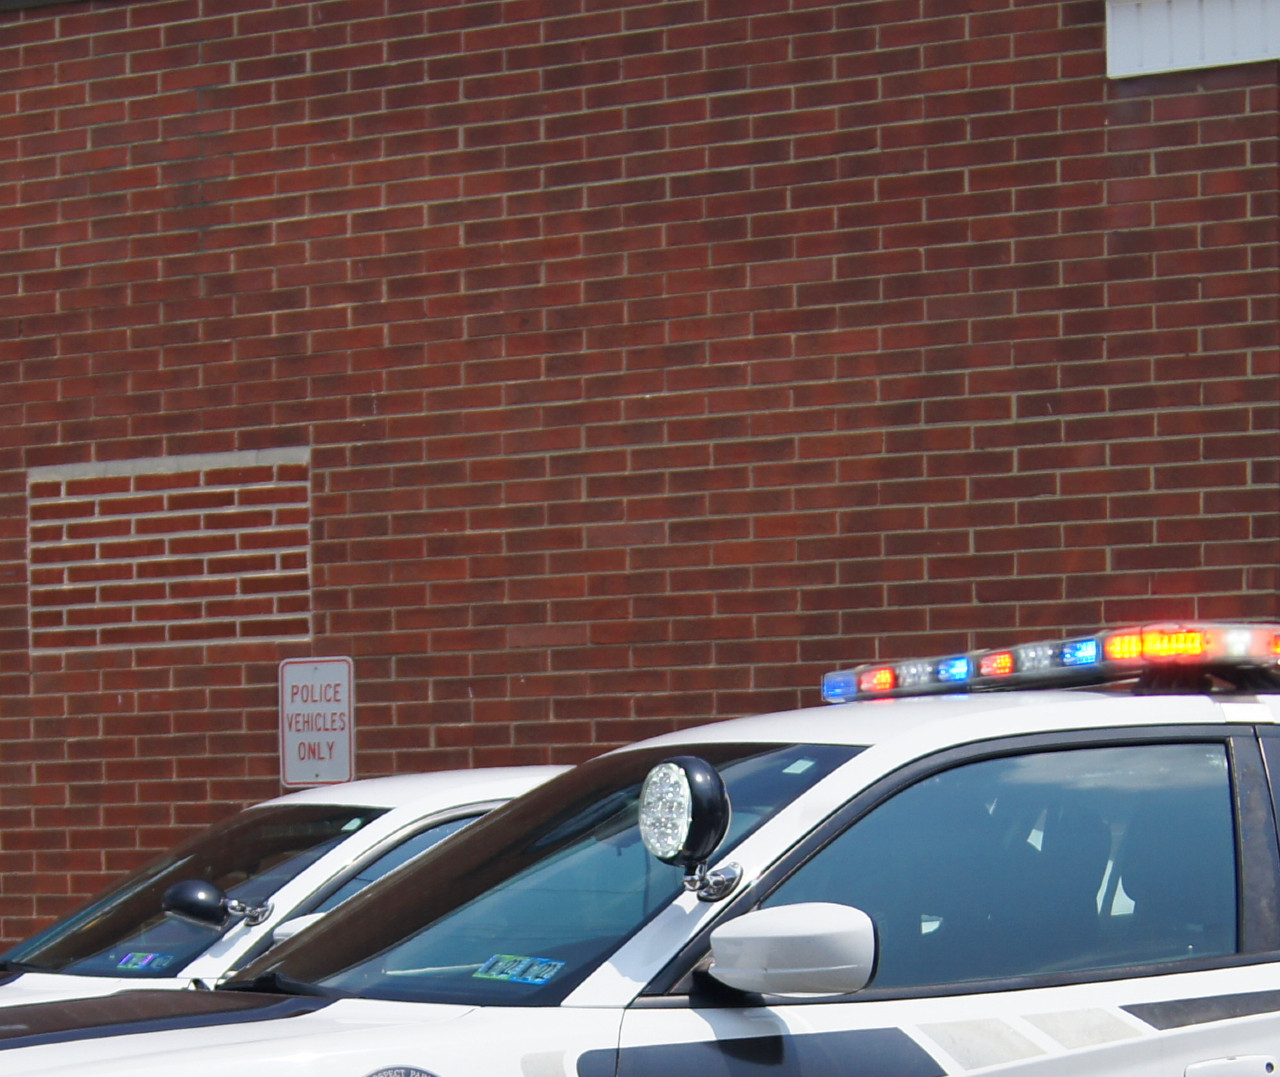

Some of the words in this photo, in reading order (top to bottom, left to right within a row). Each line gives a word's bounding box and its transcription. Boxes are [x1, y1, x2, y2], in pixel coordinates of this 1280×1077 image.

[291, 683, 342, 703] POLICE
[286, 712, 347, 732] VEHICLES
[298, 741, 335, 760] ONLY
